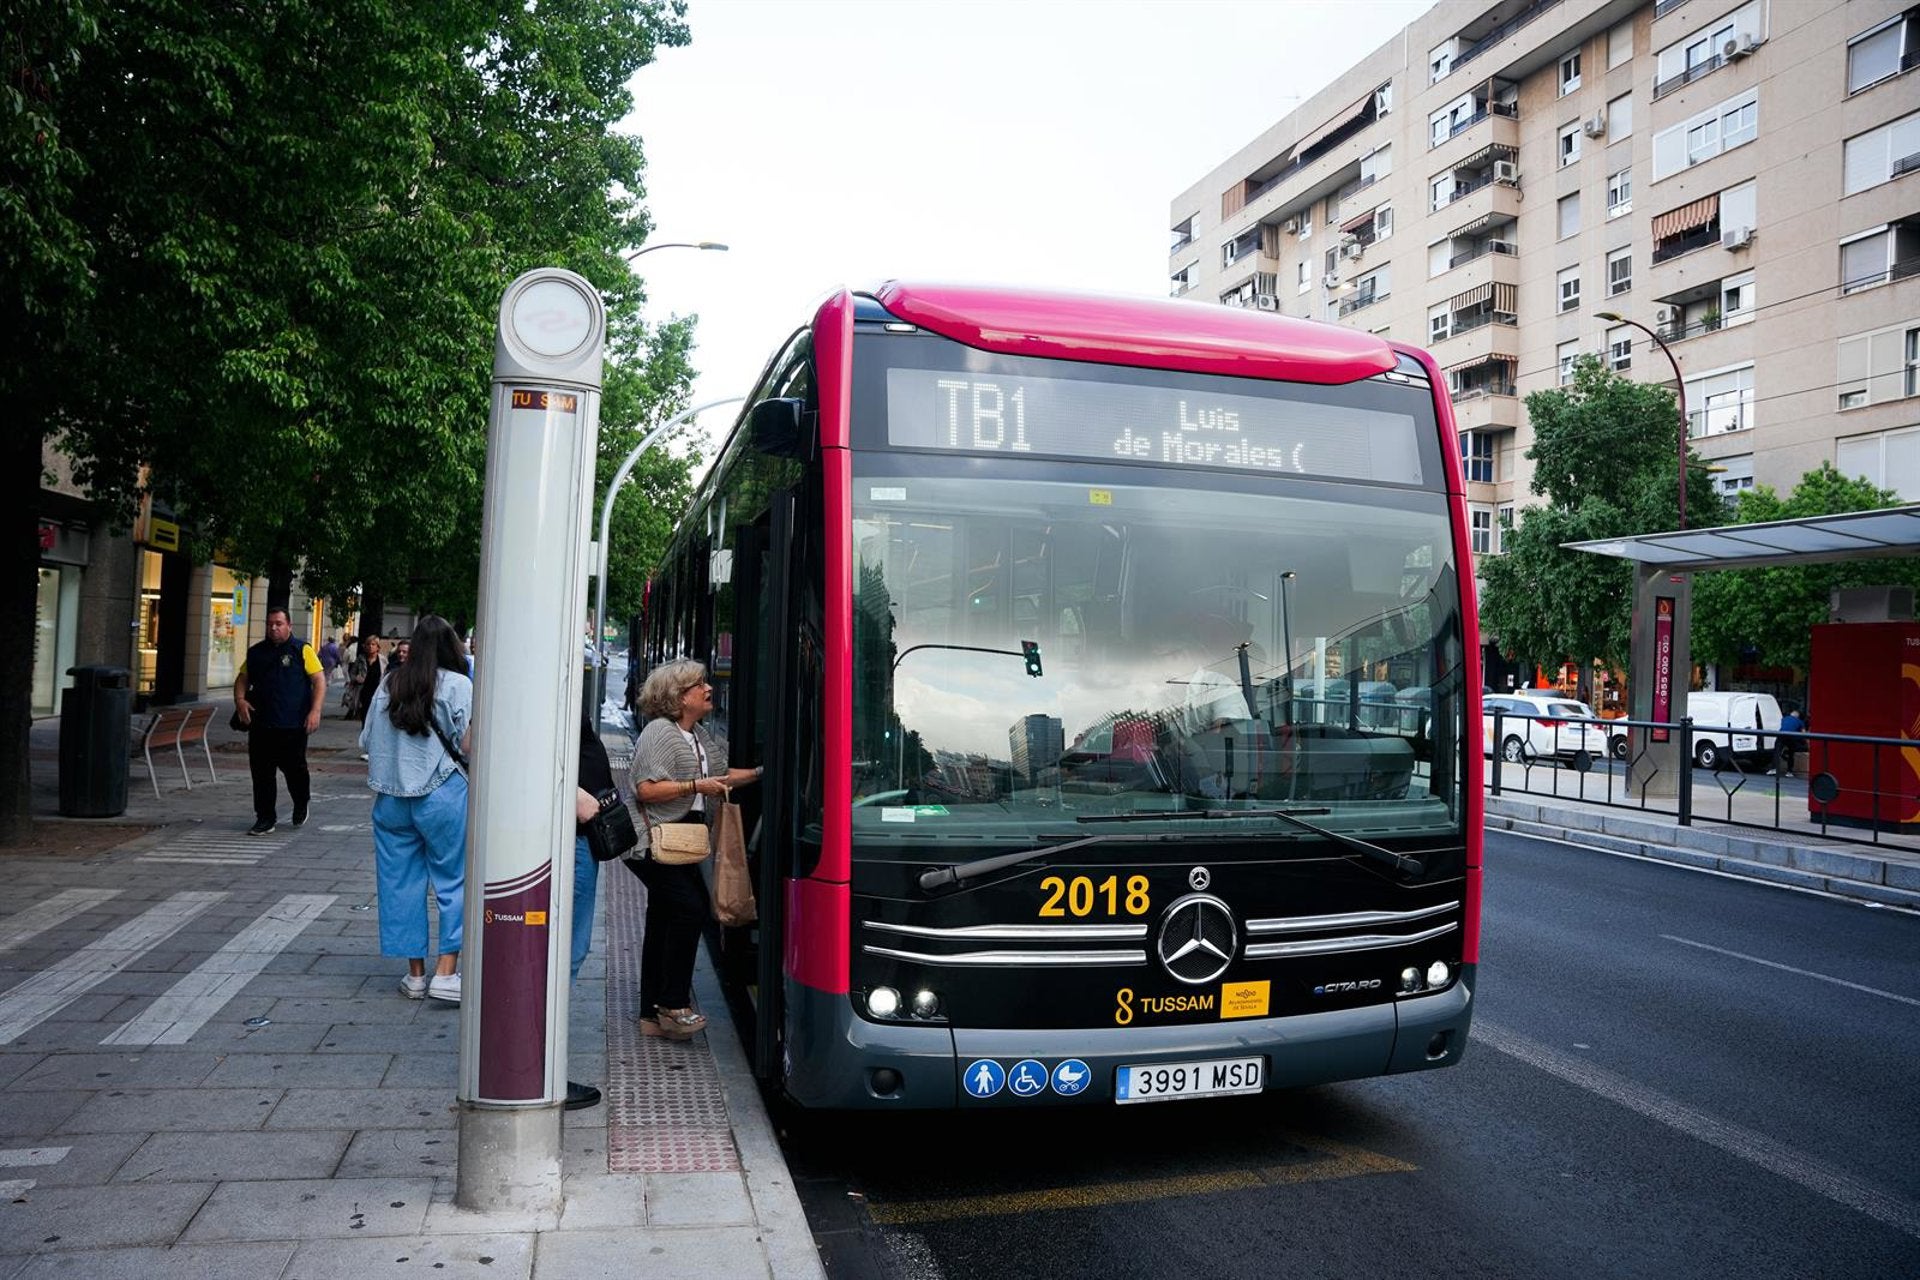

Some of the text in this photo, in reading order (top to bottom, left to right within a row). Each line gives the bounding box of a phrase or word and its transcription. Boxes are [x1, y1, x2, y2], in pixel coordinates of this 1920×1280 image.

[938, 379, 1031, 451] TB1
[1180, 400, 1239, 431] Luis
[1114, 427, 1150, 457] de
[1162, 431, 1282, 468] Morales
[1038, 874, 1151, 917] 2018
[494, 913, 524, 922] TUSSAM
[1141, 995, 1214, 1014] TUSSAM
[1138, 1062, 1259, 1095] 3991 MSD
